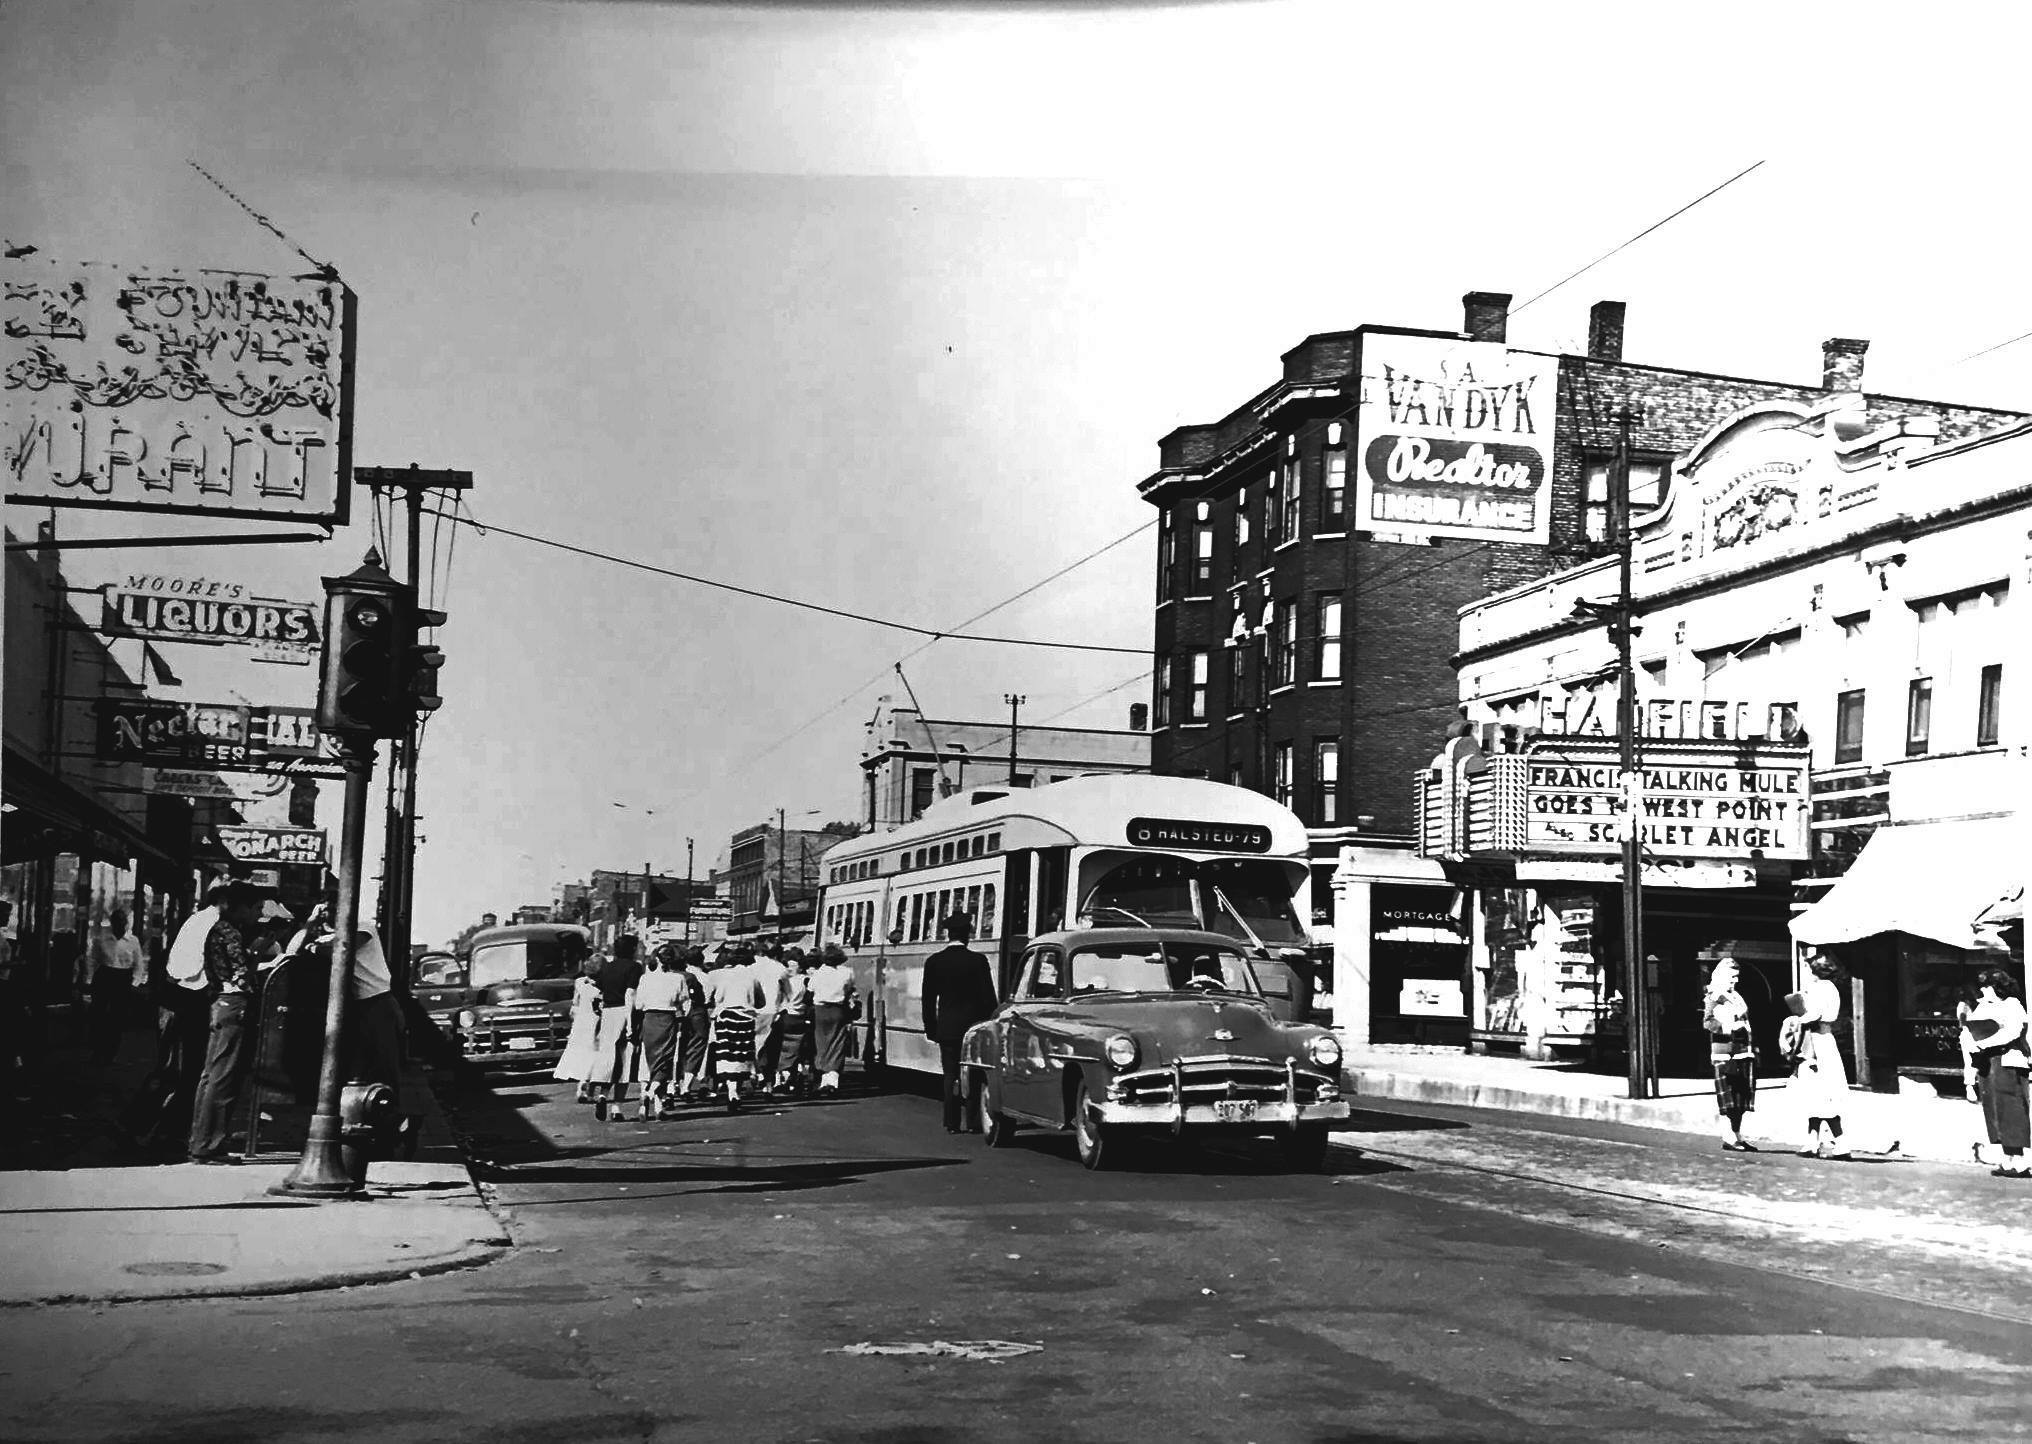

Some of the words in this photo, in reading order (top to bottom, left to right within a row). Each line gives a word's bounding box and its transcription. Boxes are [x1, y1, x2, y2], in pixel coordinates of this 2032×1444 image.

[1387, 436, 1531, 490] Realtor
[124, 575, 243, 599] MOORE'S
[122, 594, 309, 641] LIQUORS
[1642, 770, 1728, 792] TALKING
[1740, 772, 1799, 793] MULE
[1534, 795, 1593, 815] GOES
[1642, 797, 1704, 818] WEST
[1717, 800, 1788, 821] POINT
[1588, 823, 1694, 846] SCLET
[1706, 827, 1785, 848] ANGEL
[1383, 910, 1451, 921] MORTGAGE
